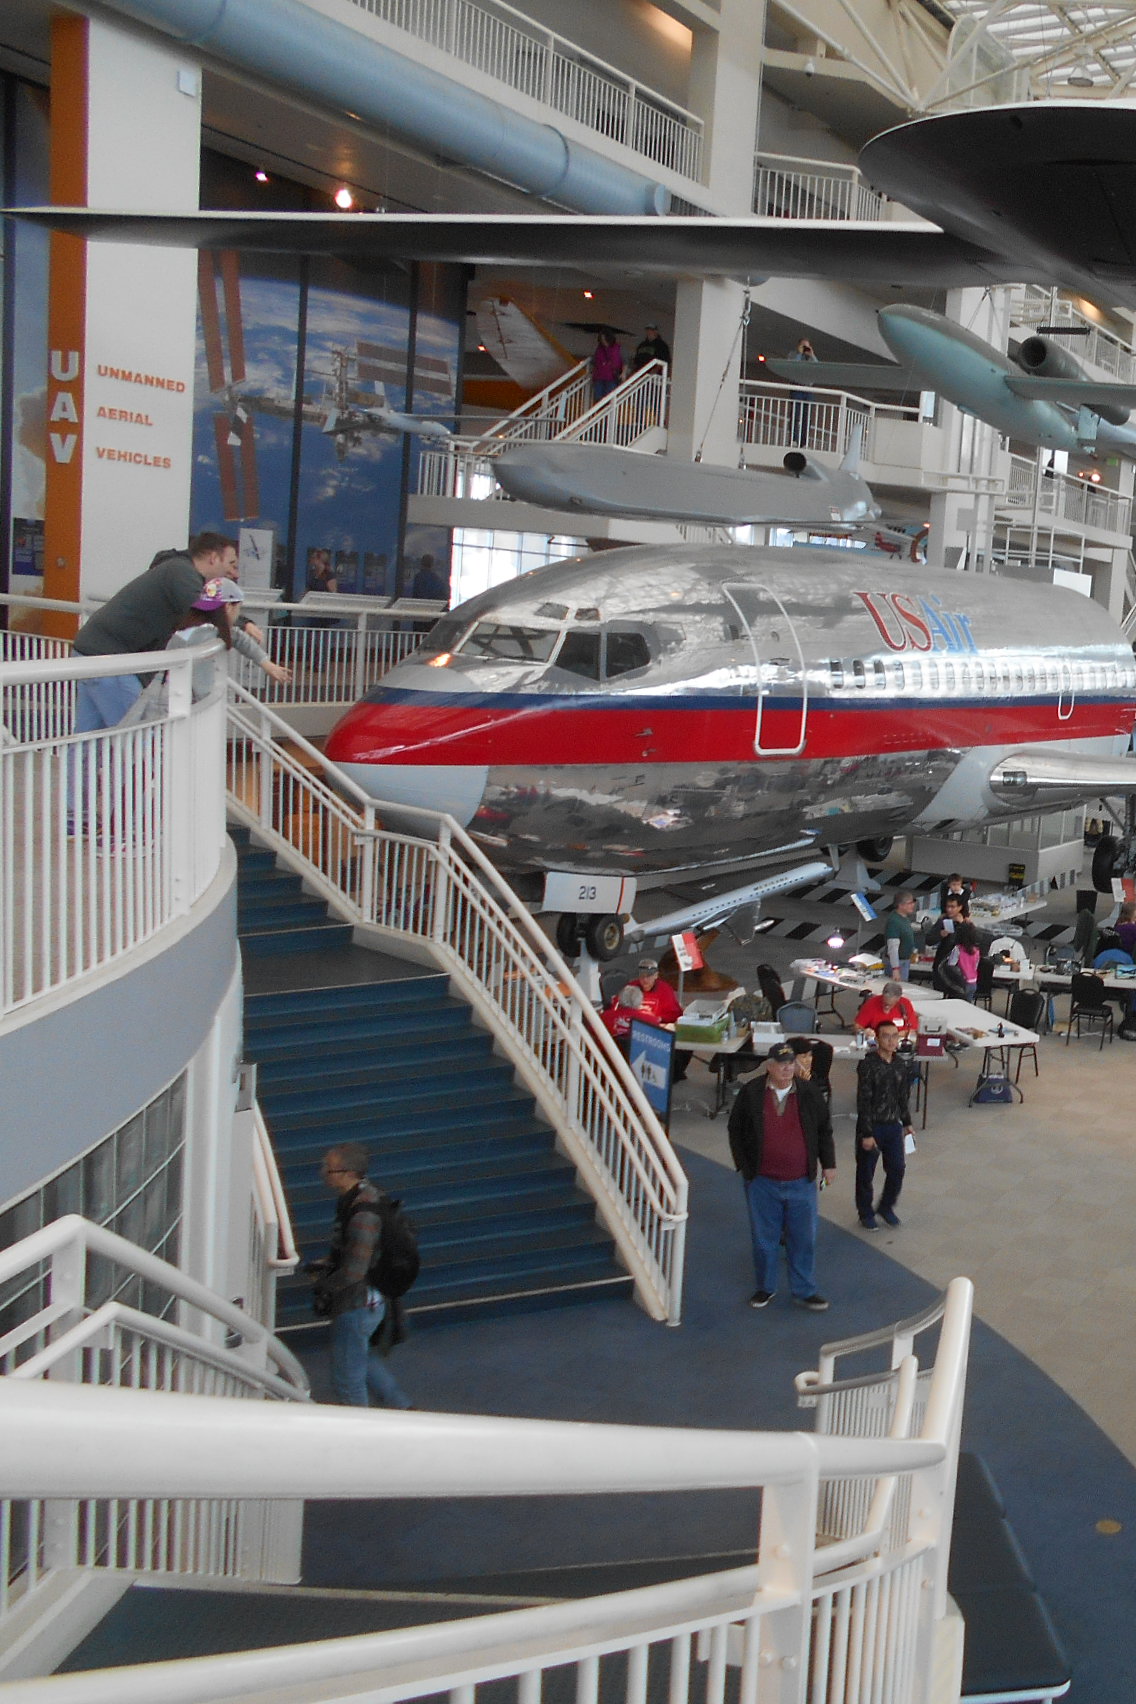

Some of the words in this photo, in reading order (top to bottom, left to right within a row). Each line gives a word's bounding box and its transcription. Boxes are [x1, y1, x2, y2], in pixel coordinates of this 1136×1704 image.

[97, 364, 186, 393] UNMANNED
[50, 350, 79, 464] UAV
[96, 406, 154, 427] AERIAL
[96, 446, 172, 469] VEHICLES
[851, 591, 978, 654] USAir
[578, 885, 597, 900] 213
[631, 1029, 671, 1053] RESTROOMS
